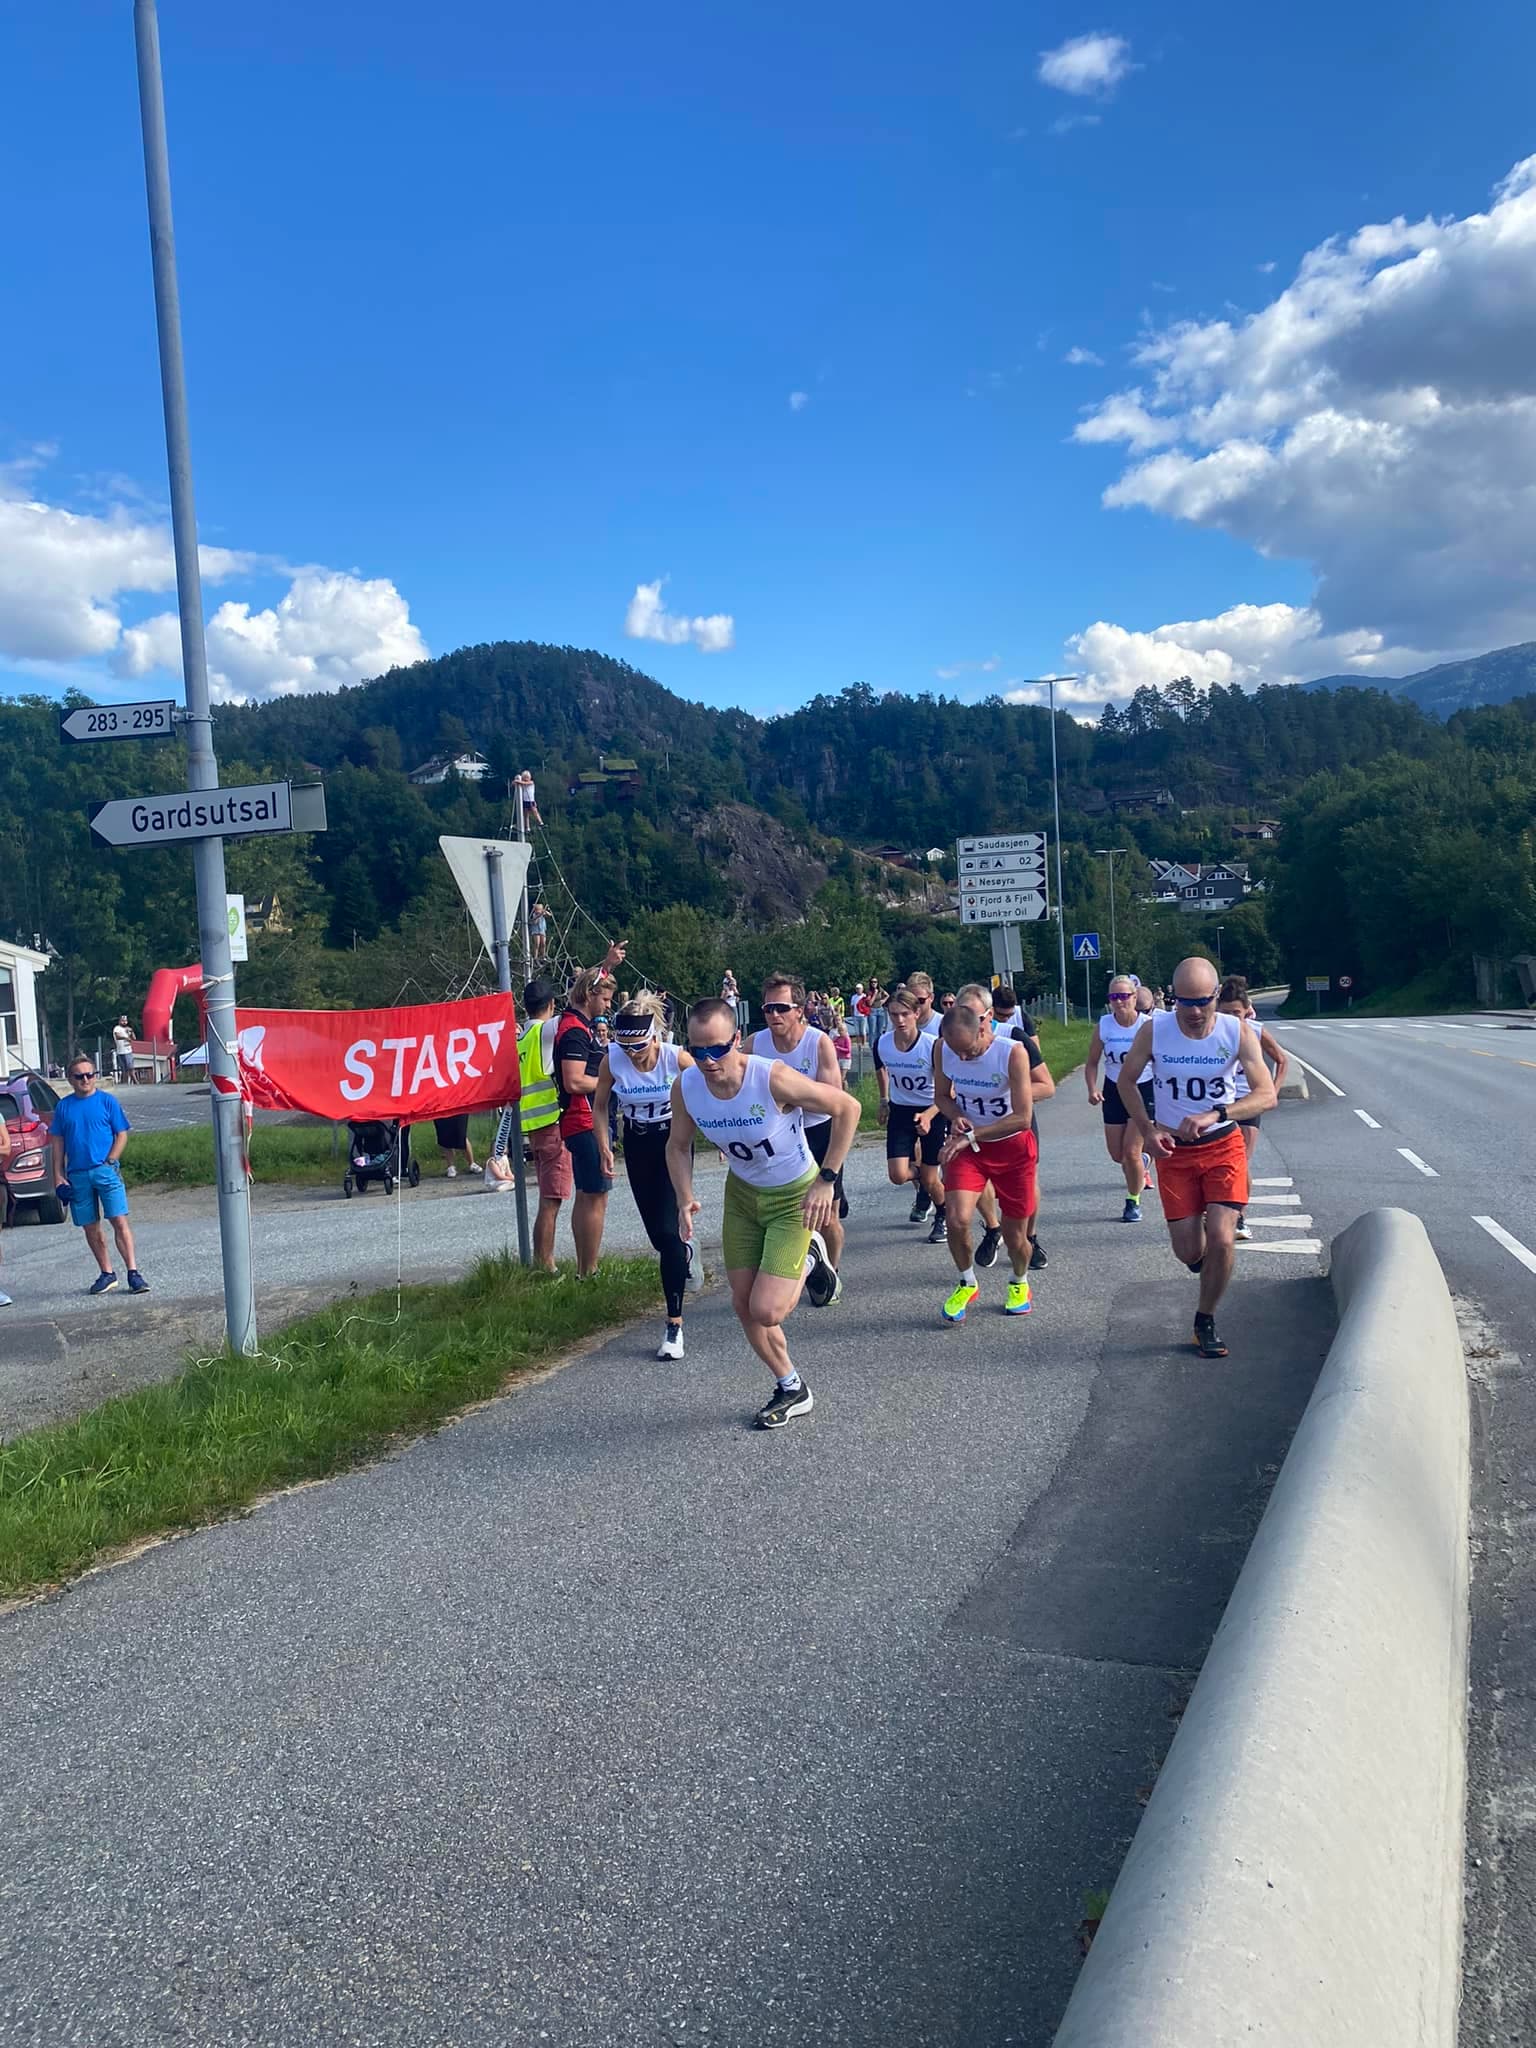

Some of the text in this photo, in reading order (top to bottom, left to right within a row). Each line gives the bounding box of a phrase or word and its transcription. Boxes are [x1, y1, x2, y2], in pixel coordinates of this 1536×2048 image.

[87, 712, 118, 732] 283
[132, 709, 164, 728] 295
[132, 791, 278, 833] Gardsutsal
[978, 839, 1029, 850] Saudasjøen
[980, 894, 1033, 905] Fjord & Fjell
[339, 1020, 506, 1101] START
[1162, 1055, 1226, 1064] Saudefaldene
[891, 1074, 929, 1091] 102
[1166, 1076, 1226, 1101] 103
[957, 1093, 1008, 1117] 113
[696, 1116, 763, 1128] Saudefaldene
